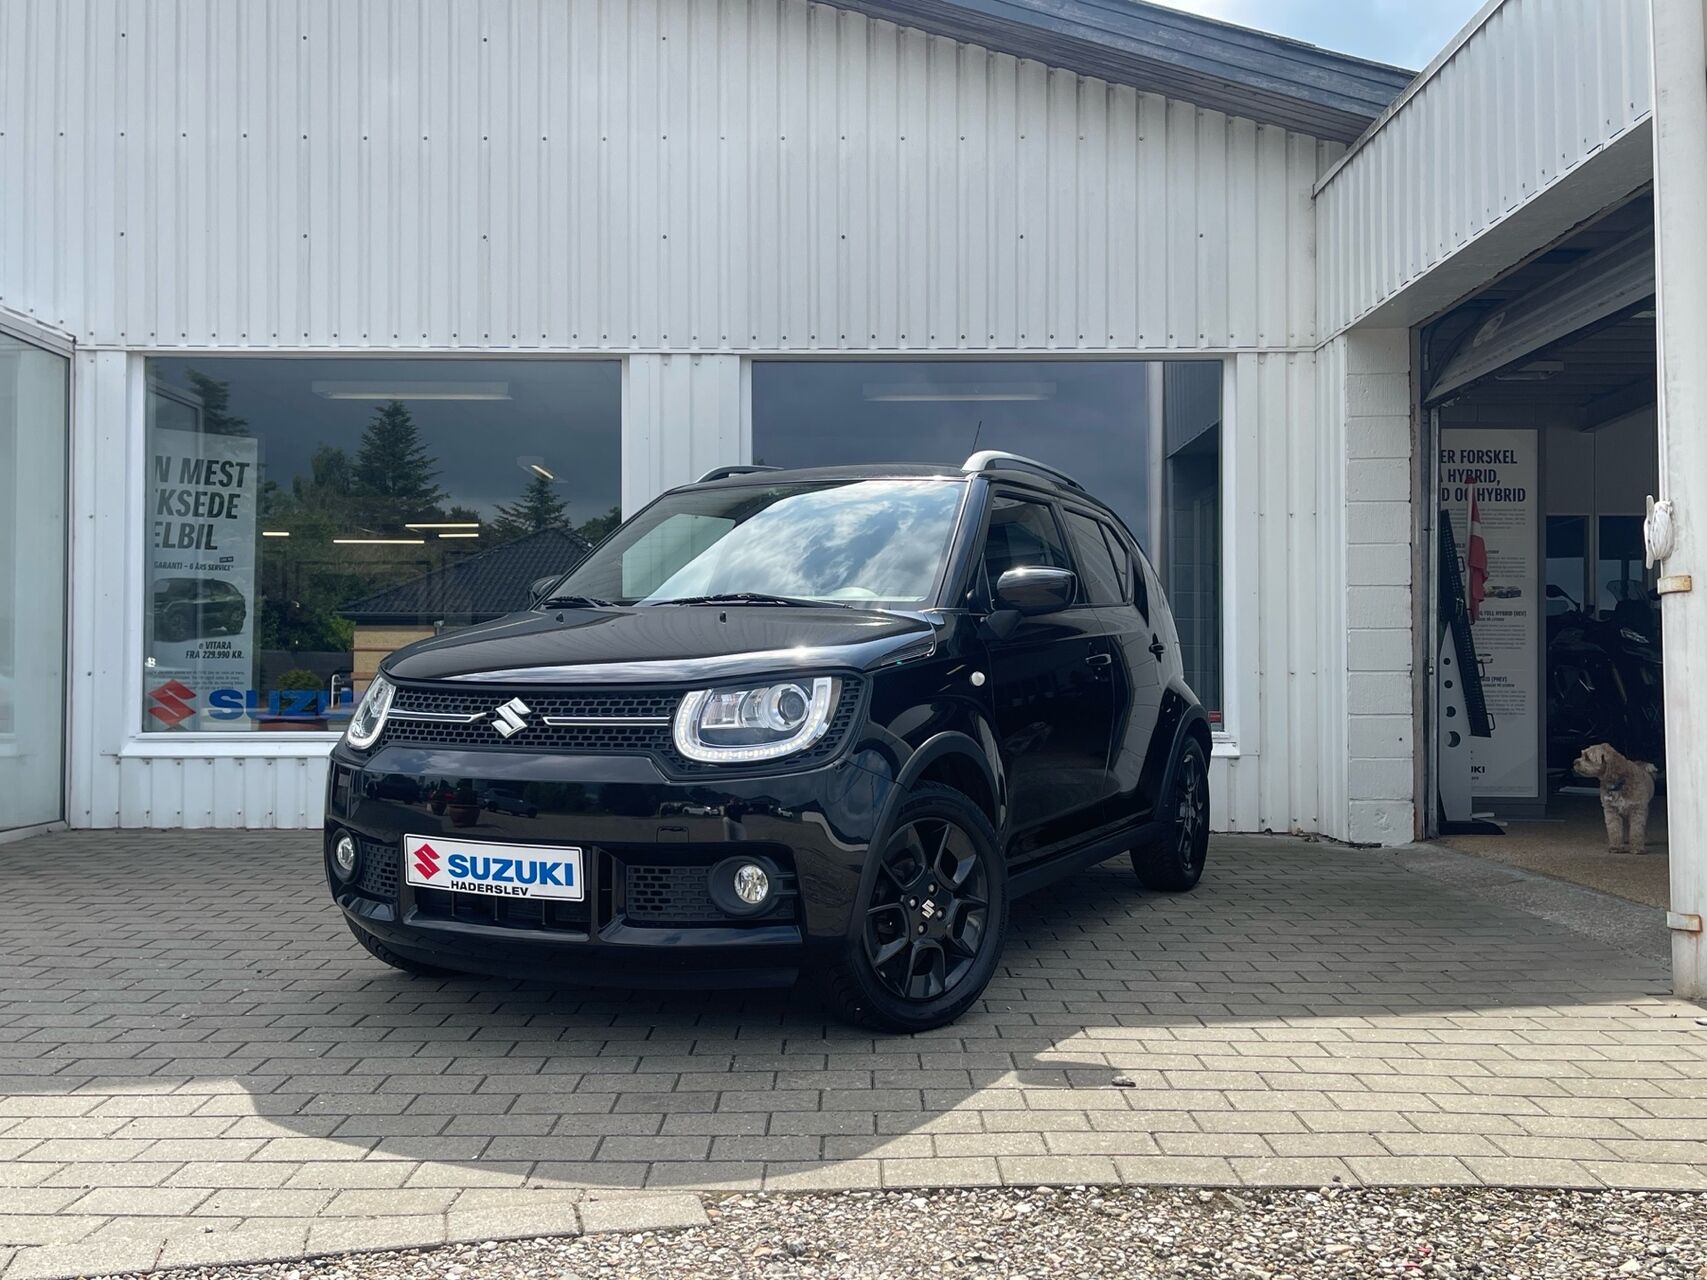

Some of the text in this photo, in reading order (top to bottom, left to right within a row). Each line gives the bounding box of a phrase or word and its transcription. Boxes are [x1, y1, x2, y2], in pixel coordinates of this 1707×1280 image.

[1440, 449, 1518, 464] ER FORSKEL
[179, 457, 250, 488] MEST
[1447, 468, 1501, 486] HYBRID,
[1477, 487, 1526, 502] HYBRID
[155, 488, 241, 519] KSEDE
[154, 561, 183, 570] GARANTI
[205, 641, 232, 650] VITARA
[185, 650, 245, 659] FRA 229.990 KR.
[208, 689, 354, 721] SUZU
[447, 853, 574, 887] SUZUKI
[450, 880, 529, 897] HADERSLEV
